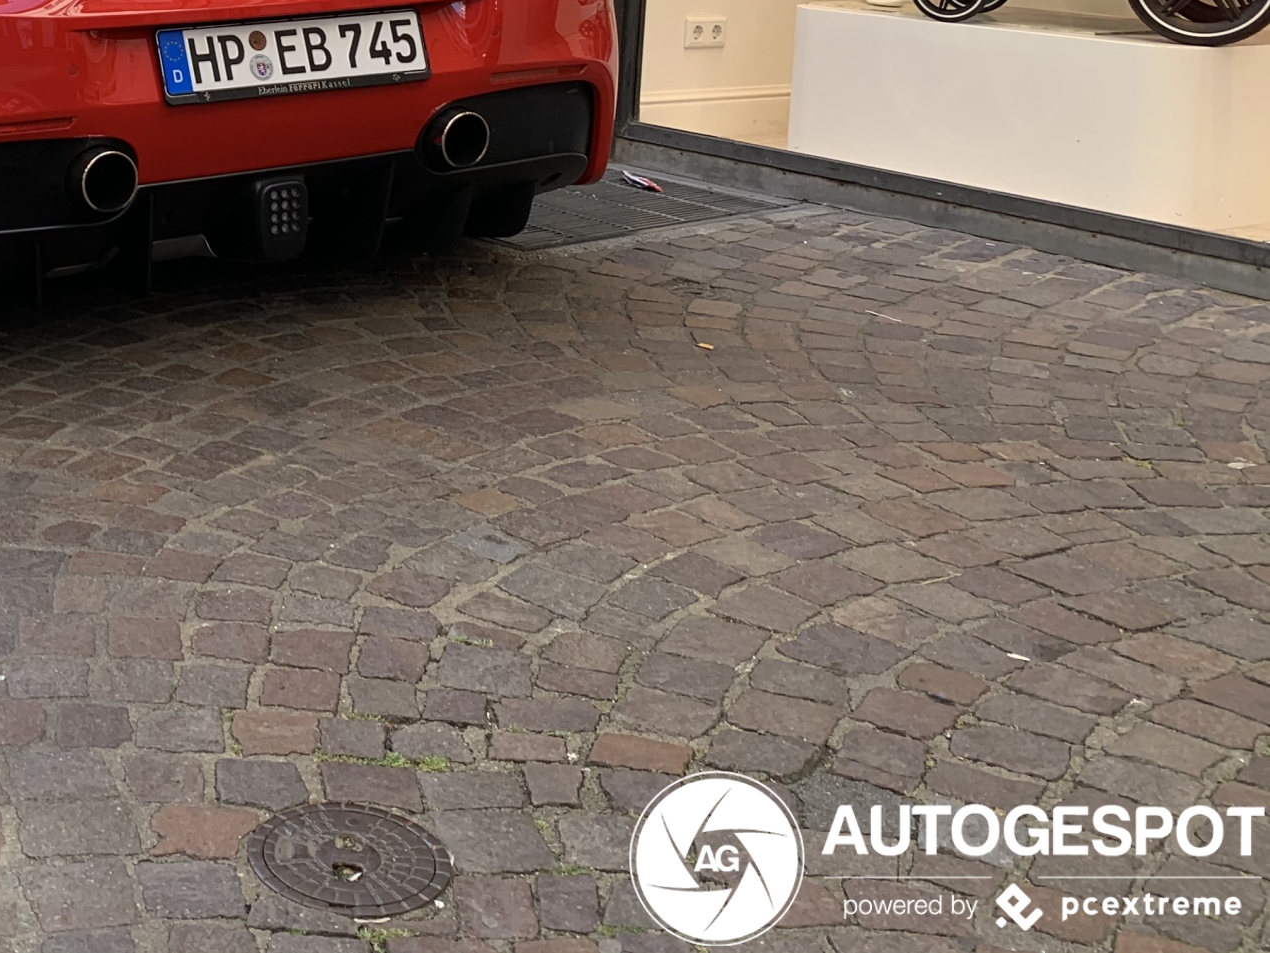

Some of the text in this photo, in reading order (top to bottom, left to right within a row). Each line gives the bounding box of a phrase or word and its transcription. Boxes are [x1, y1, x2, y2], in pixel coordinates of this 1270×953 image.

[188, 19, 417, 84] HP EB 745
[172, 69, 184, 84] D
[289, 81, 321, 92] Ferrari
[321, 79, 351, 88] Kassel
